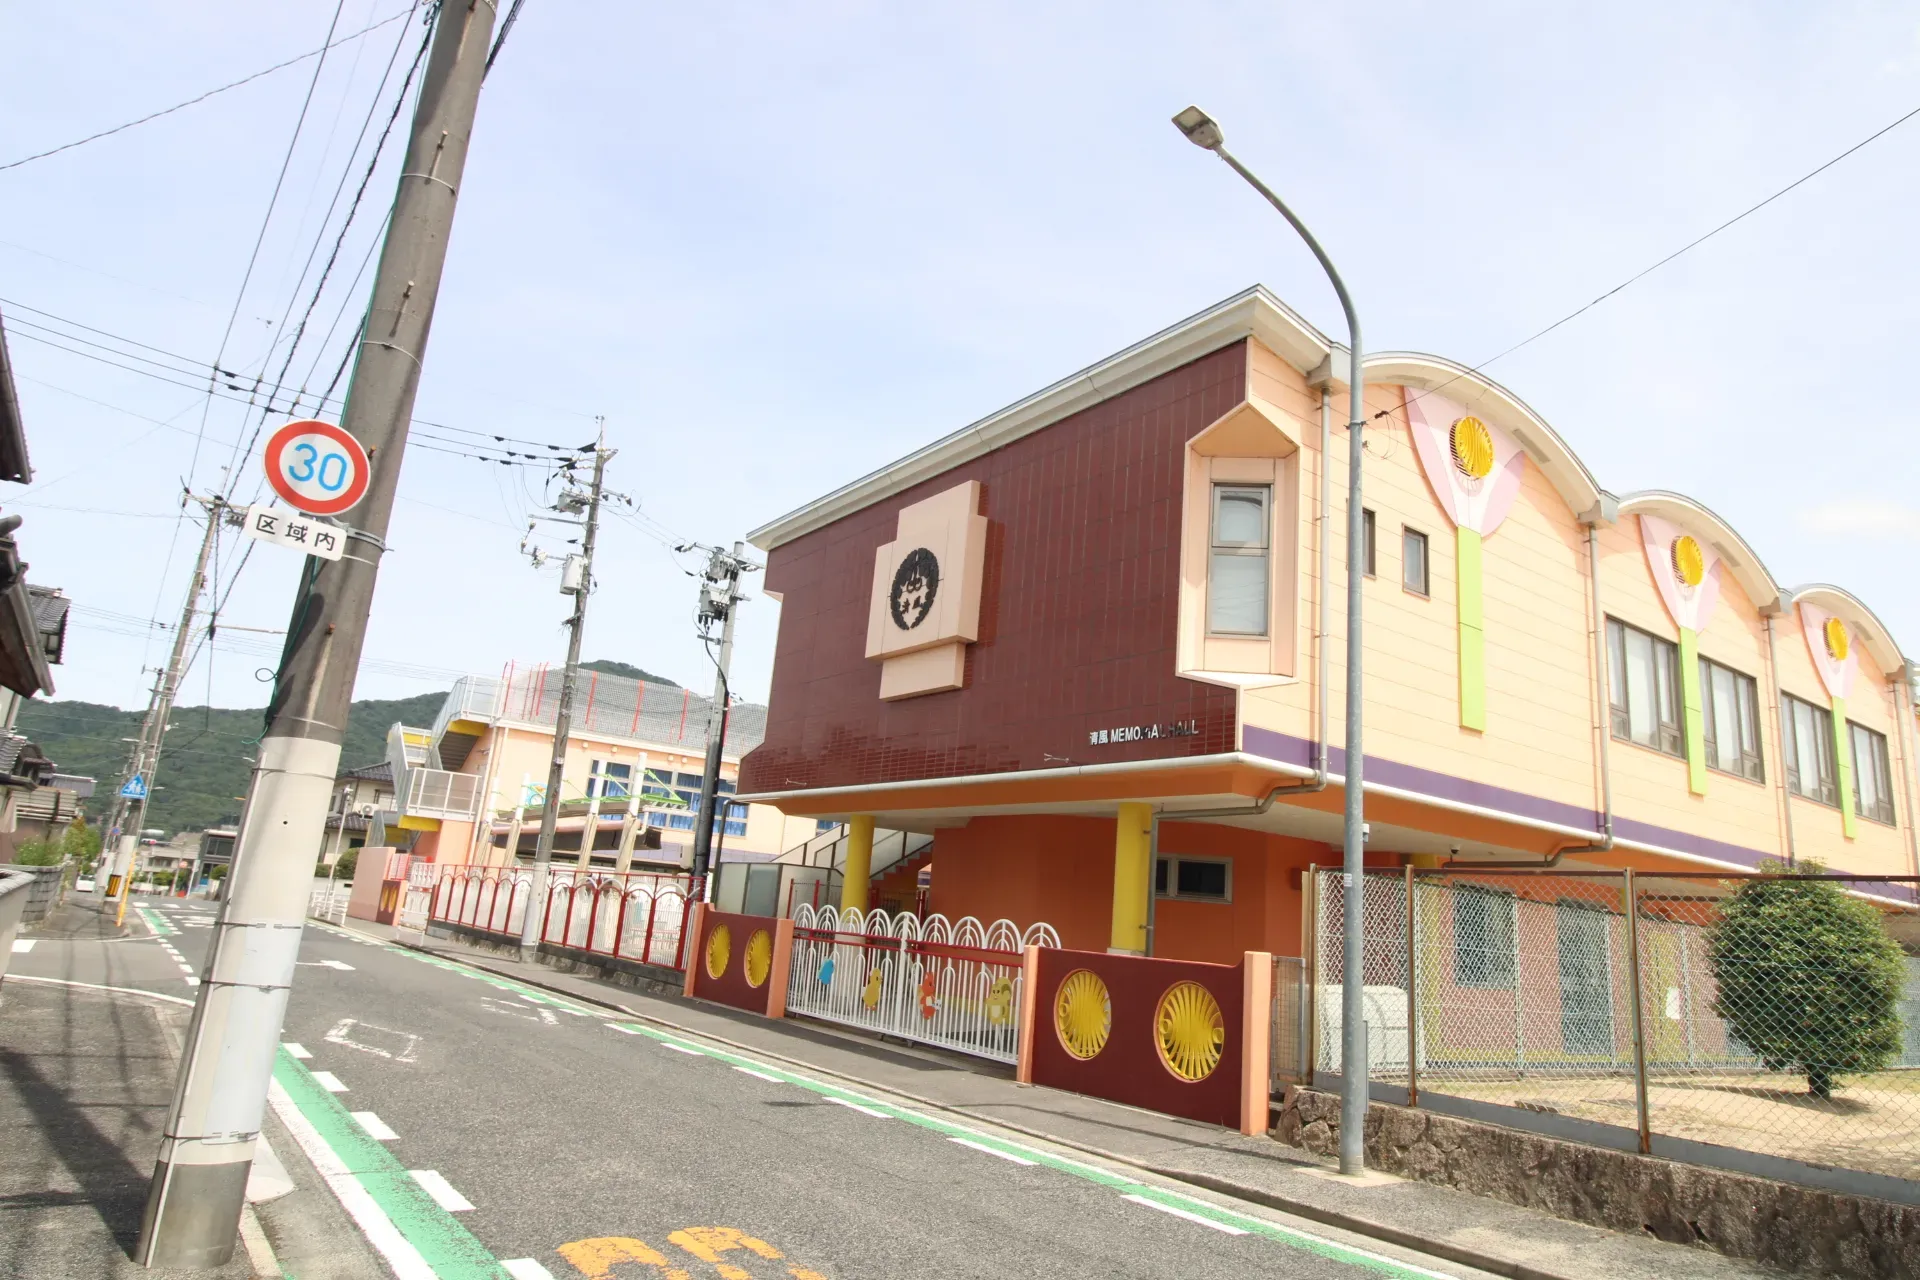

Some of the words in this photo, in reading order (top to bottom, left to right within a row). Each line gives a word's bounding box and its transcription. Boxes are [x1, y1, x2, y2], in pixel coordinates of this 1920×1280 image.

[289, 443, 347, 492] 30
[256, 514, 336, 551] 区域内
